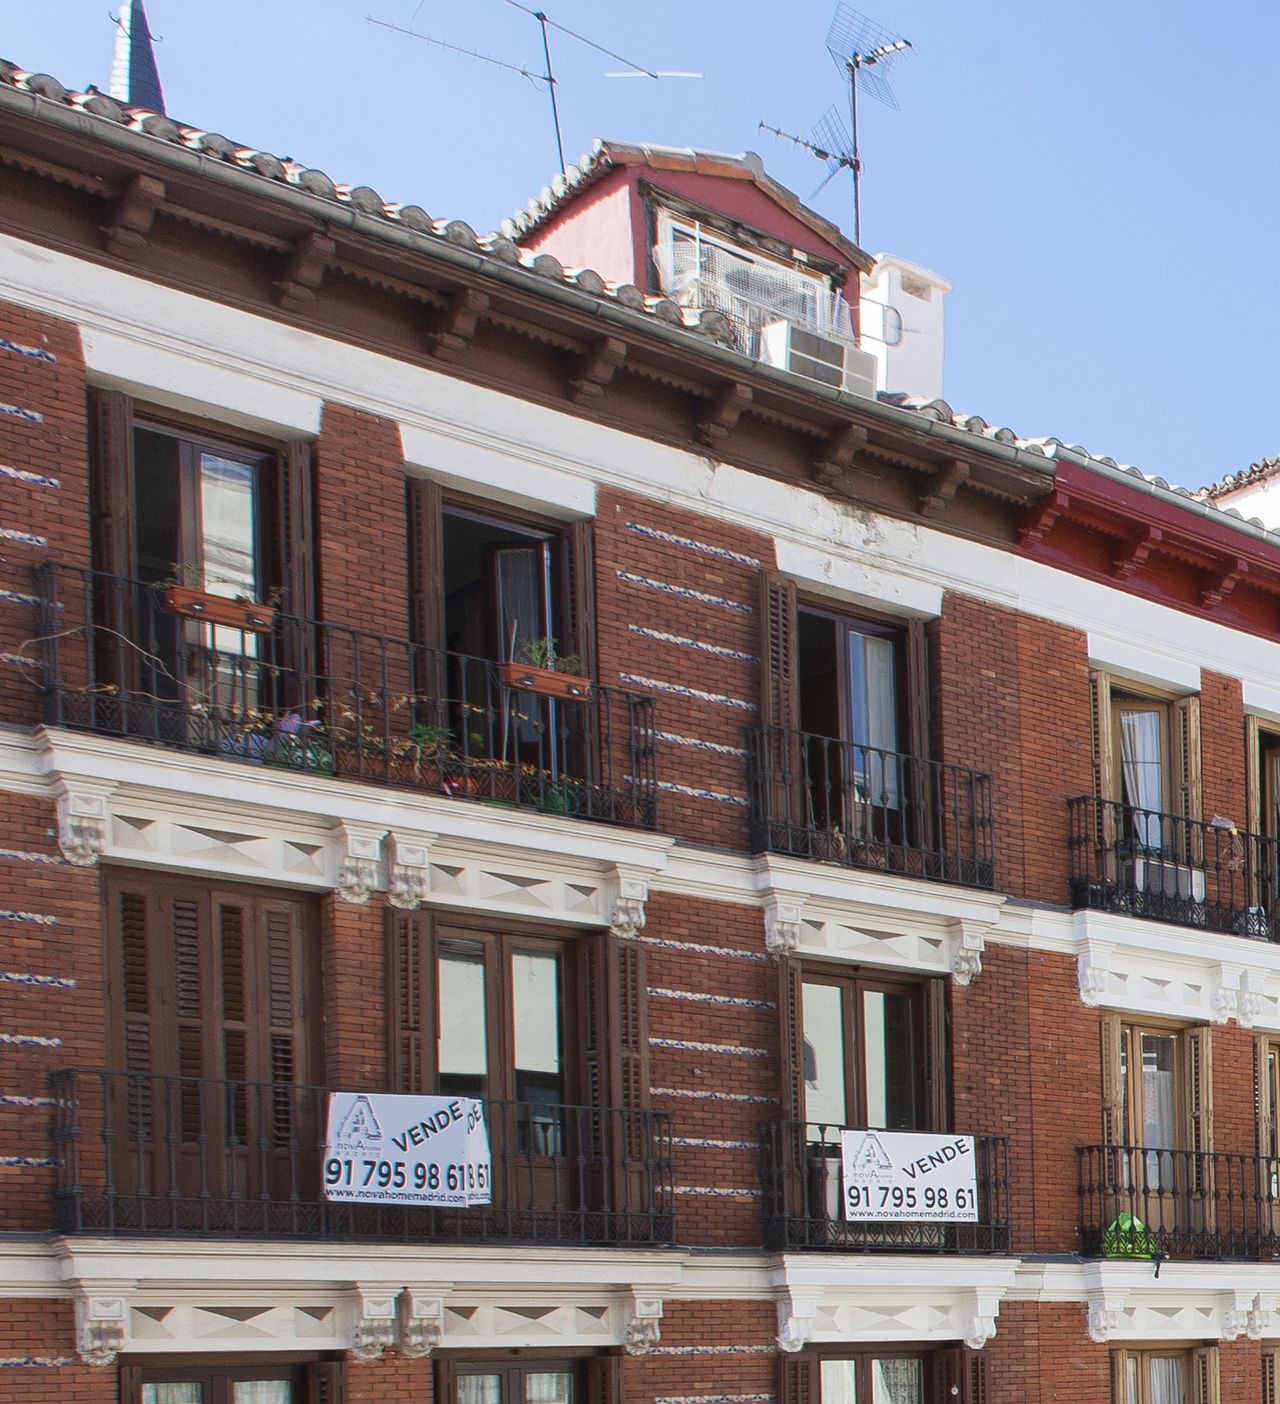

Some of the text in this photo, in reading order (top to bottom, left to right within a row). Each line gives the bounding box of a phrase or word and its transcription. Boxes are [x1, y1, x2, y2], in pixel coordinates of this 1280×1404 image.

[391, 1100, 464, 1152] VENDE
[902, 1138, 970, 1179] VENDE
[326, 1158, 466, 1191] 91 795 98 61
[325, 1189, 467, 1203] www.novahomemadrid.com
[848, 1186, 975, 1209] 91 795 98 61
[850, 1210, 976, 1219] www.novahomemadrid.com
